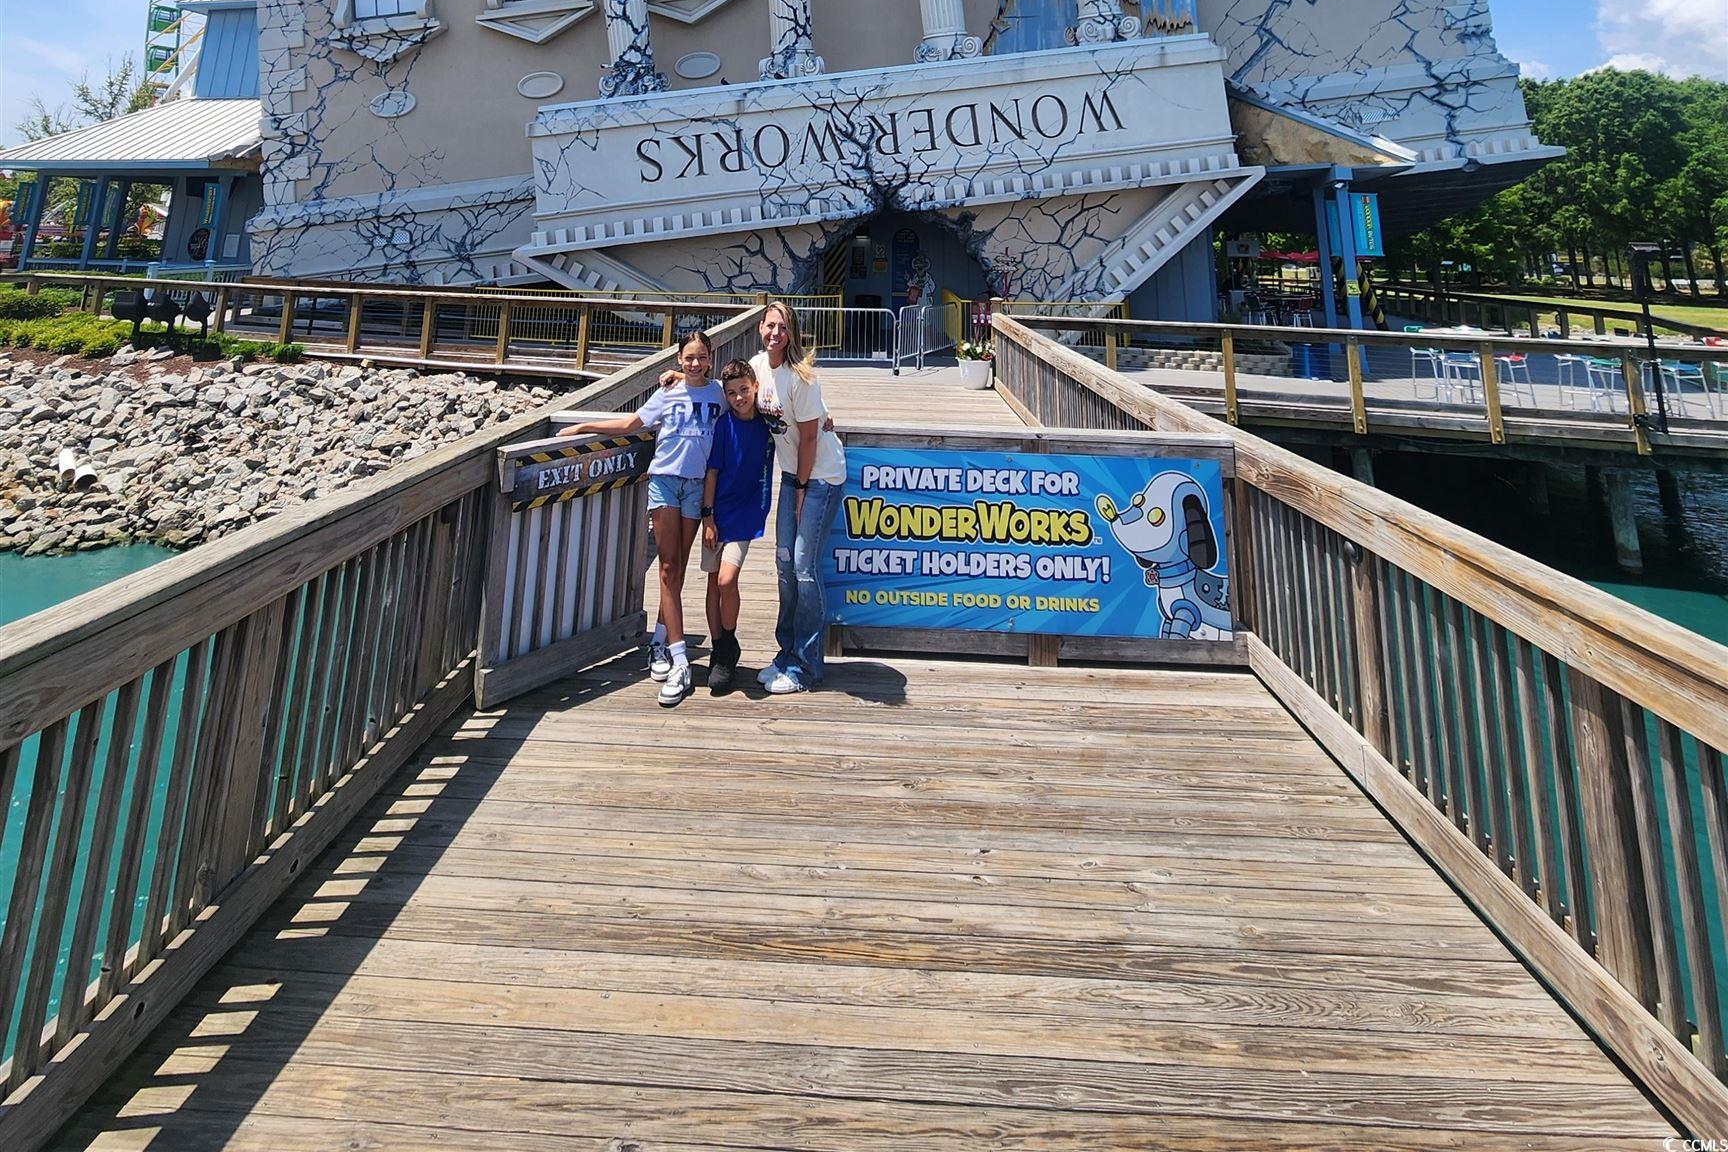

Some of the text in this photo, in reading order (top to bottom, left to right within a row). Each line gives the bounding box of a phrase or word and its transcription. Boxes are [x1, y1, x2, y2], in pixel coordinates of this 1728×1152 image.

[671, 401, 721, 428] GAP
[538, 452, 637, 490] EXIT ONLY
[862, 465, 1080, 496] PRIVATE DECK FOR
[834, 548, 1111, 583] TICKET HOLDERS ONLY!
[845, 590, 1101, 613] NO OUTSIDE FOOD OR DRINKS
